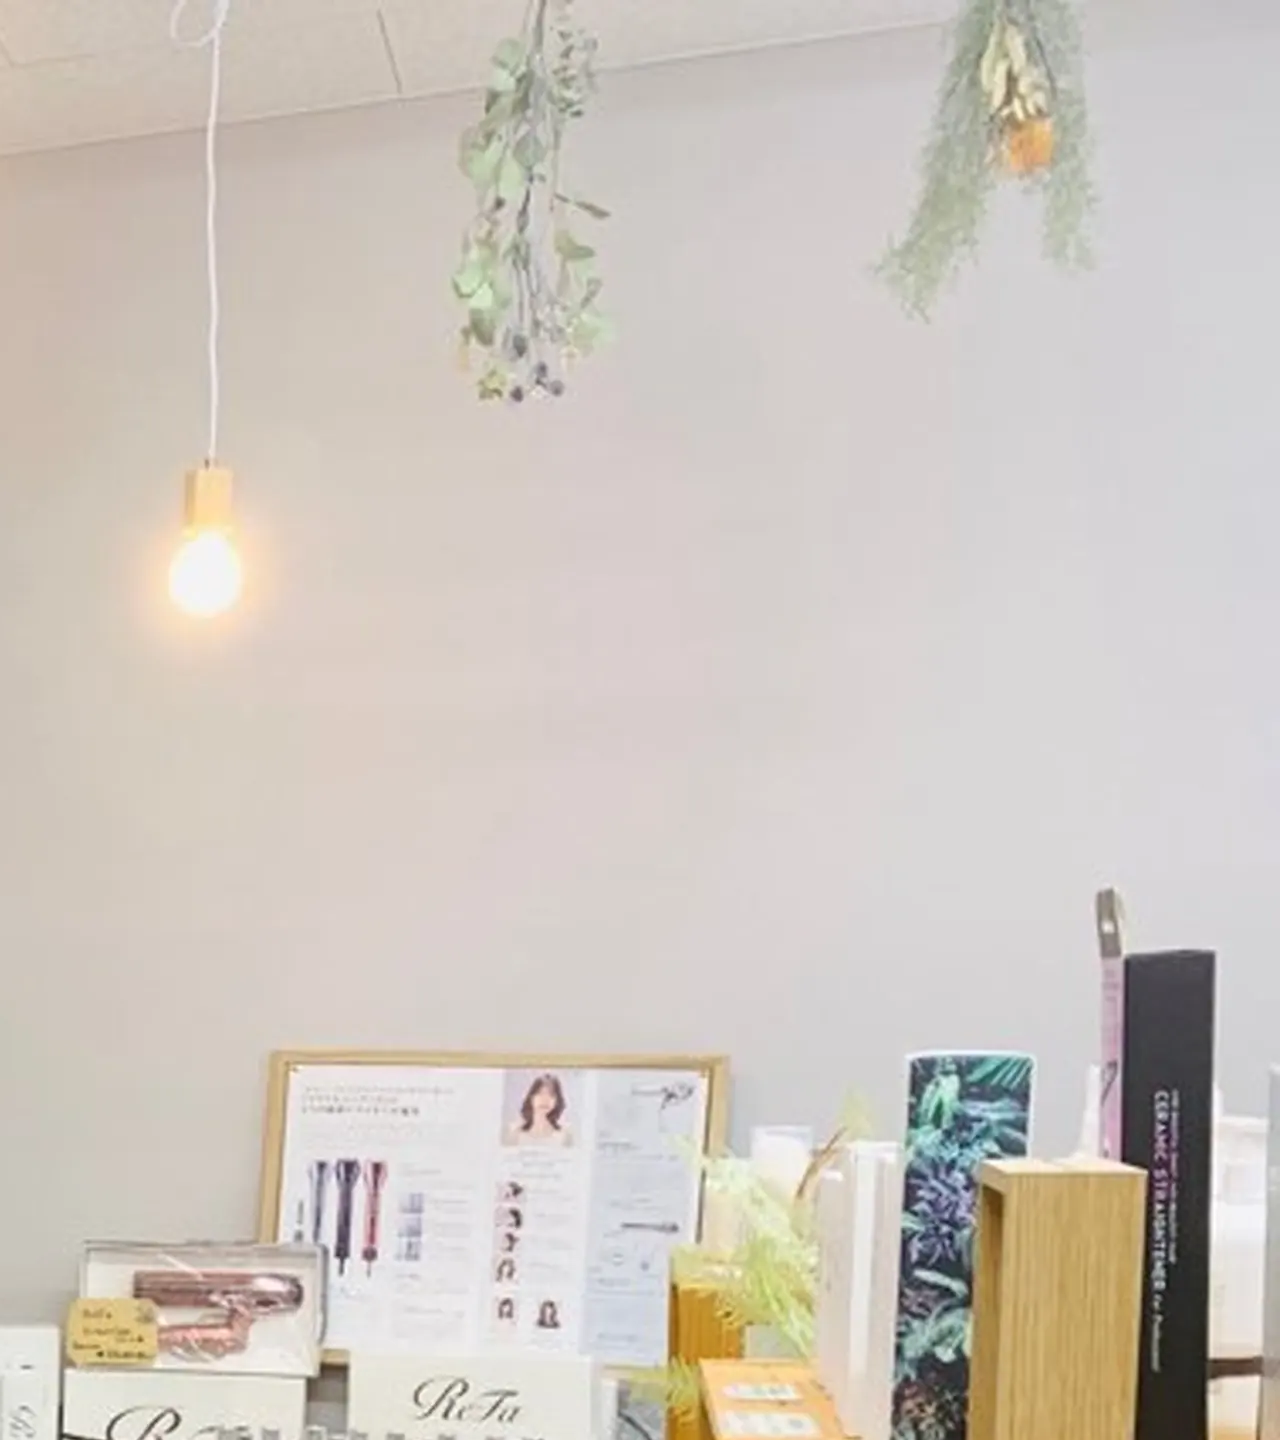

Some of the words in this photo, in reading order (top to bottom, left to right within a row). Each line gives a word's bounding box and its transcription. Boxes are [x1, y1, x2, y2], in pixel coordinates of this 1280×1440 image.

[1153, 1089, 1170, 1163] CERAMIC
[1151, 1168, 1169, 1291] STRAIGHTENER
[413, 1375, 521, 1423] ReFa
